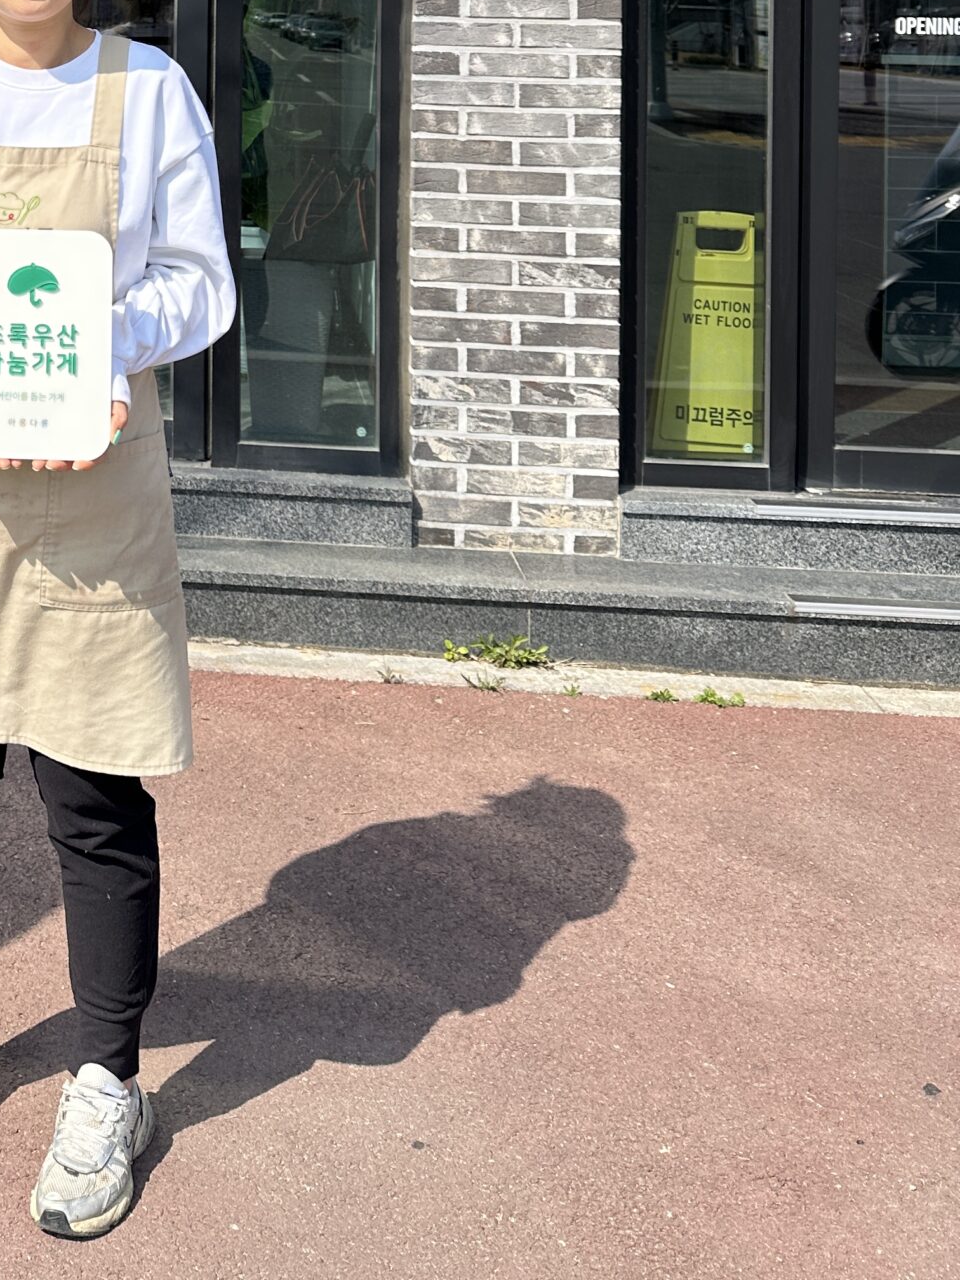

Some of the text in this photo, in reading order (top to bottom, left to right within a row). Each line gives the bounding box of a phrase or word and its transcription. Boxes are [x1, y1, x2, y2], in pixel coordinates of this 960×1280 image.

[693, 298, 751, 314] CAUTION
[682, 313, 755, 329] WET FLOO
